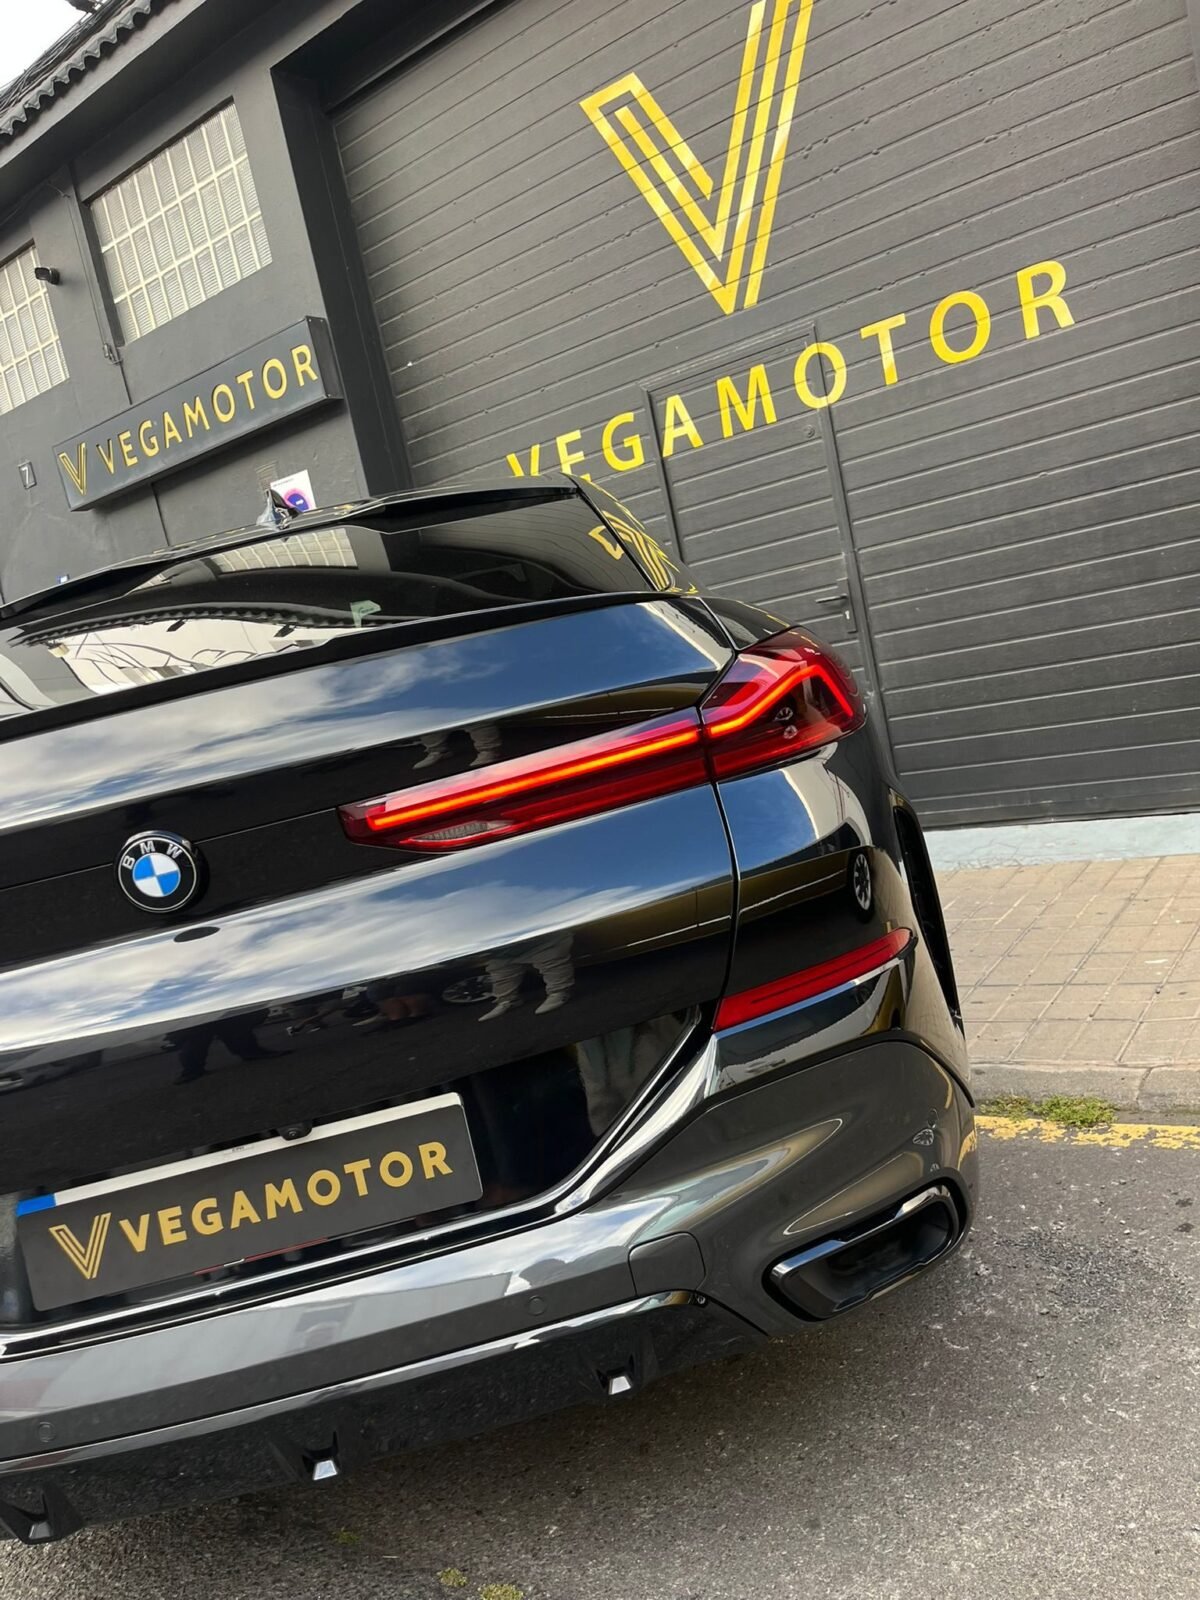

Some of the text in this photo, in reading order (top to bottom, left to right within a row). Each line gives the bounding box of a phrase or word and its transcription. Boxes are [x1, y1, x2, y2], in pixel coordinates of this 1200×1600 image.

[96, 344, 319, 475] VEGAMOTOR
[506, 260, 1075, 483] VEGAMOTOR
[121, 840, 183, 870] BMW
[119, 1141, 453, 1253] VEGAMOTOR
